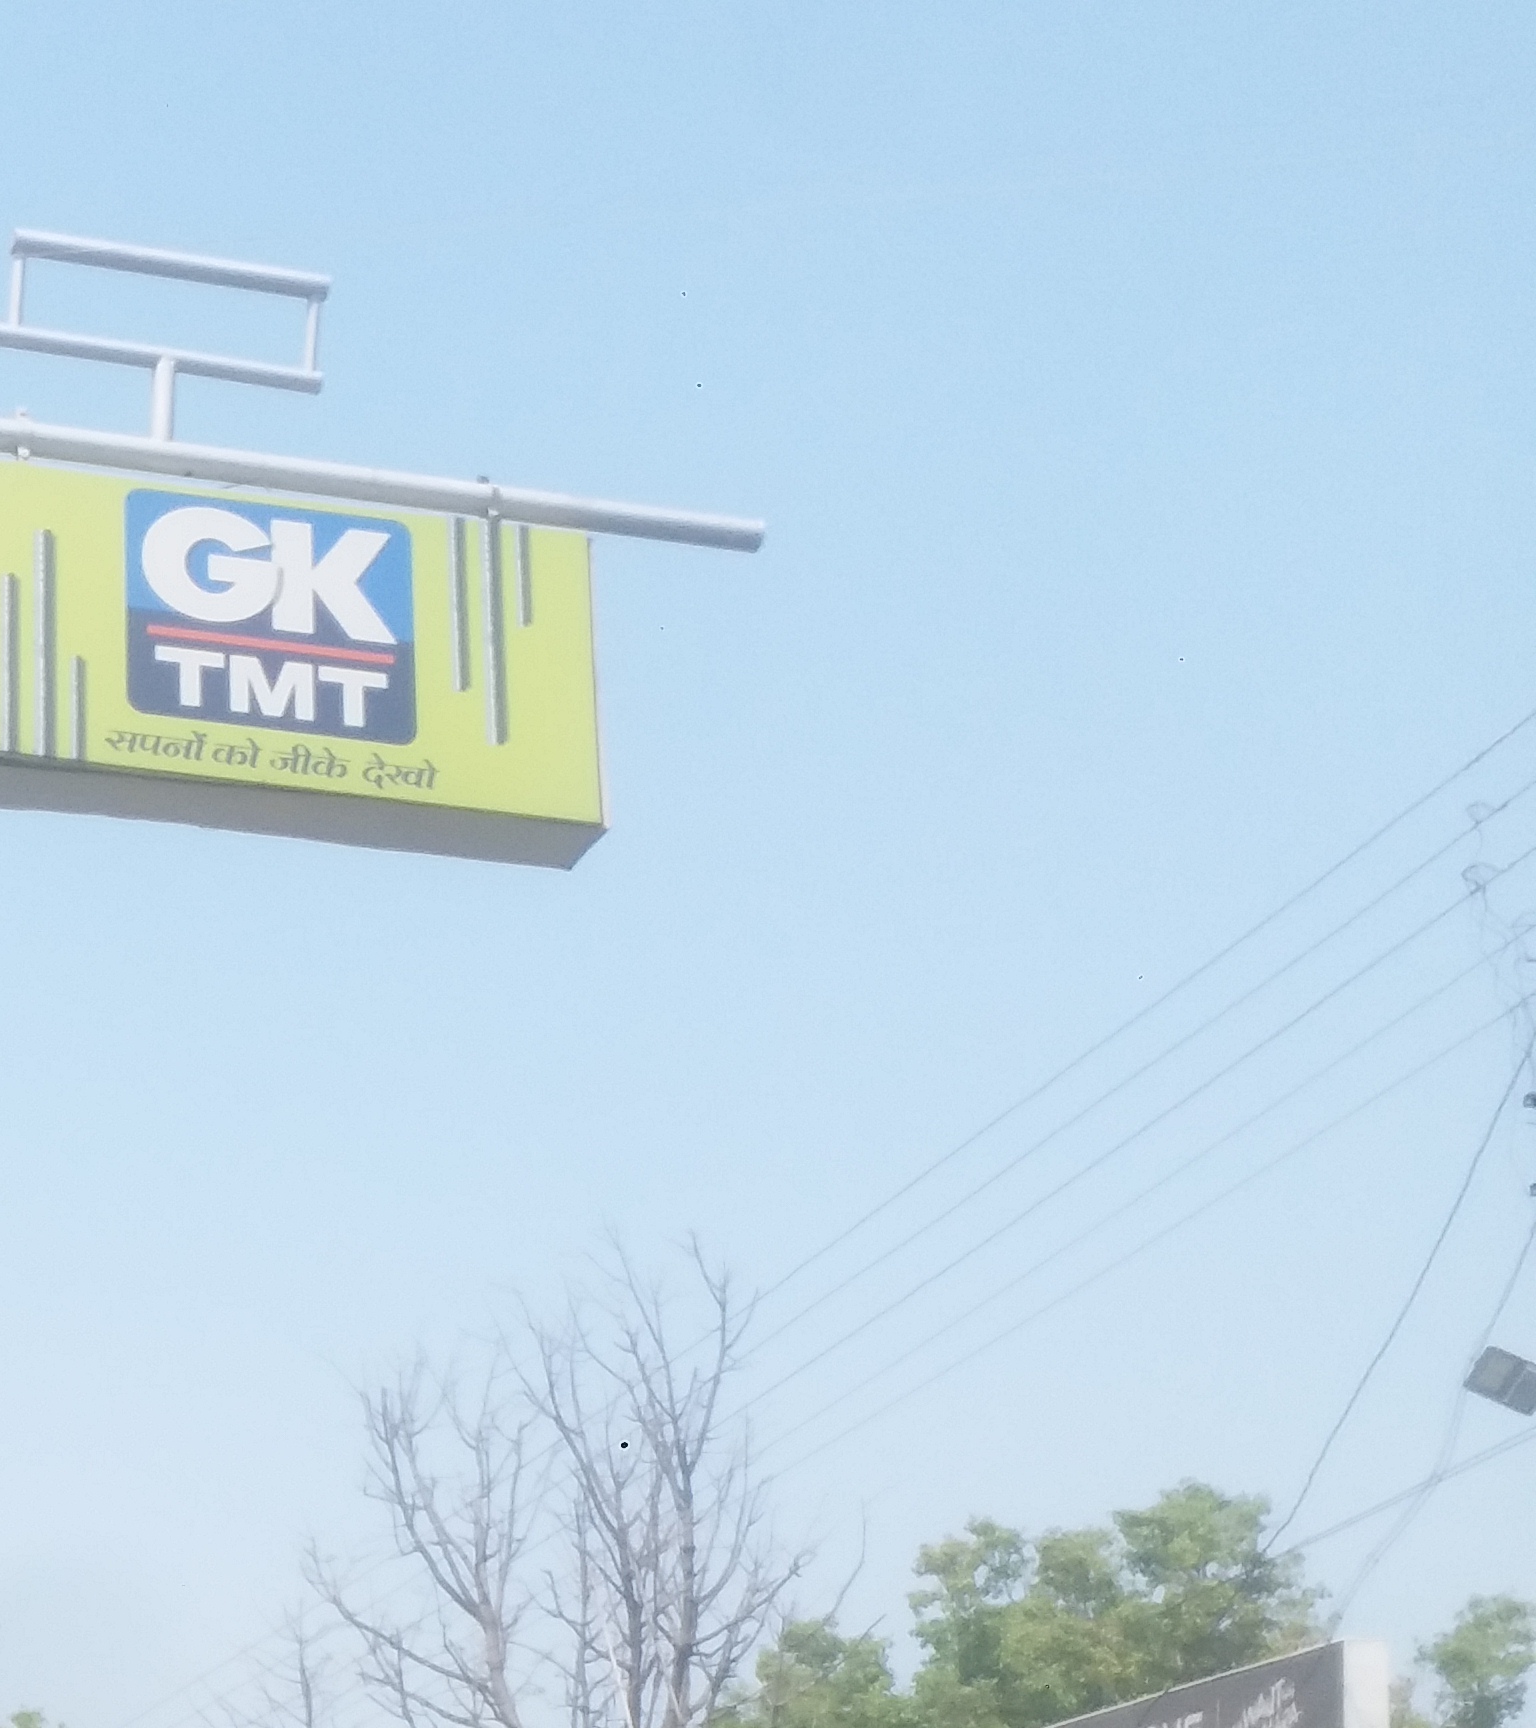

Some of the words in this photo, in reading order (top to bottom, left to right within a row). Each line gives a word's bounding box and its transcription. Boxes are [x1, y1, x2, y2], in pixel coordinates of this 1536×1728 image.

[141, 506, 397, 645] GK
[153, 645, 391, 729] TMT
[105, 729, 207, 763] सपनों
[212, 737, 262, 772] को
[269, 746, 350, 781] जीके
[361, 752, 439, 791] देखो
